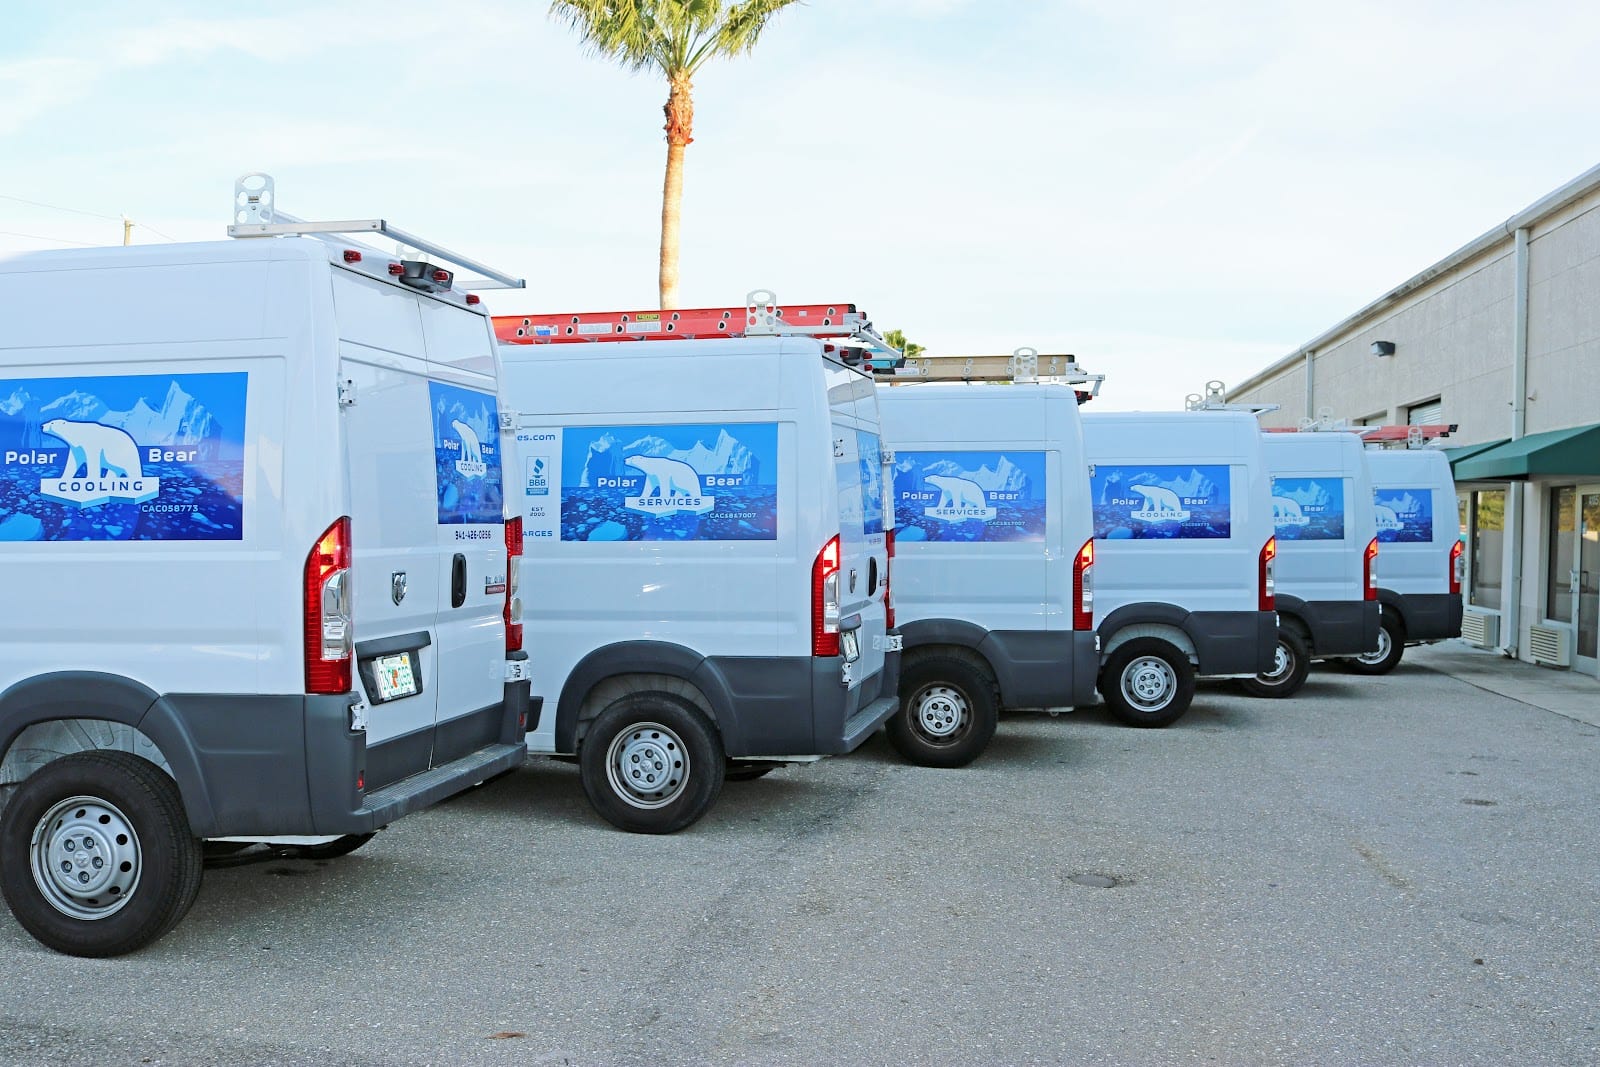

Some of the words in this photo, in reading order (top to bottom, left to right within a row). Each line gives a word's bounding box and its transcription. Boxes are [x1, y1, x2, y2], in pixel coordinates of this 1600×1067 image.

[443, 439, 460, 451] Polar
[481, 444, 494, 455] Bear
[5, 450, 57, 465] Polar
[149, 448, 198, 463] Bear
[460, 462, 483, 473] COOLING
[58, 481, 144, 492] COOLING
[529, 479, 546, 487] BBB
[597, 477, 638, 488] Polar
[705, 476, 743, 487] Bear
[902, 491, 935, 500] Polar
[989, 491, 1019, 500] Bear
[638, 498, 702, 506] SERVICES
[1184, 497, 1209, 505] Bear
[141, 504, 199, 513] CAC058773
